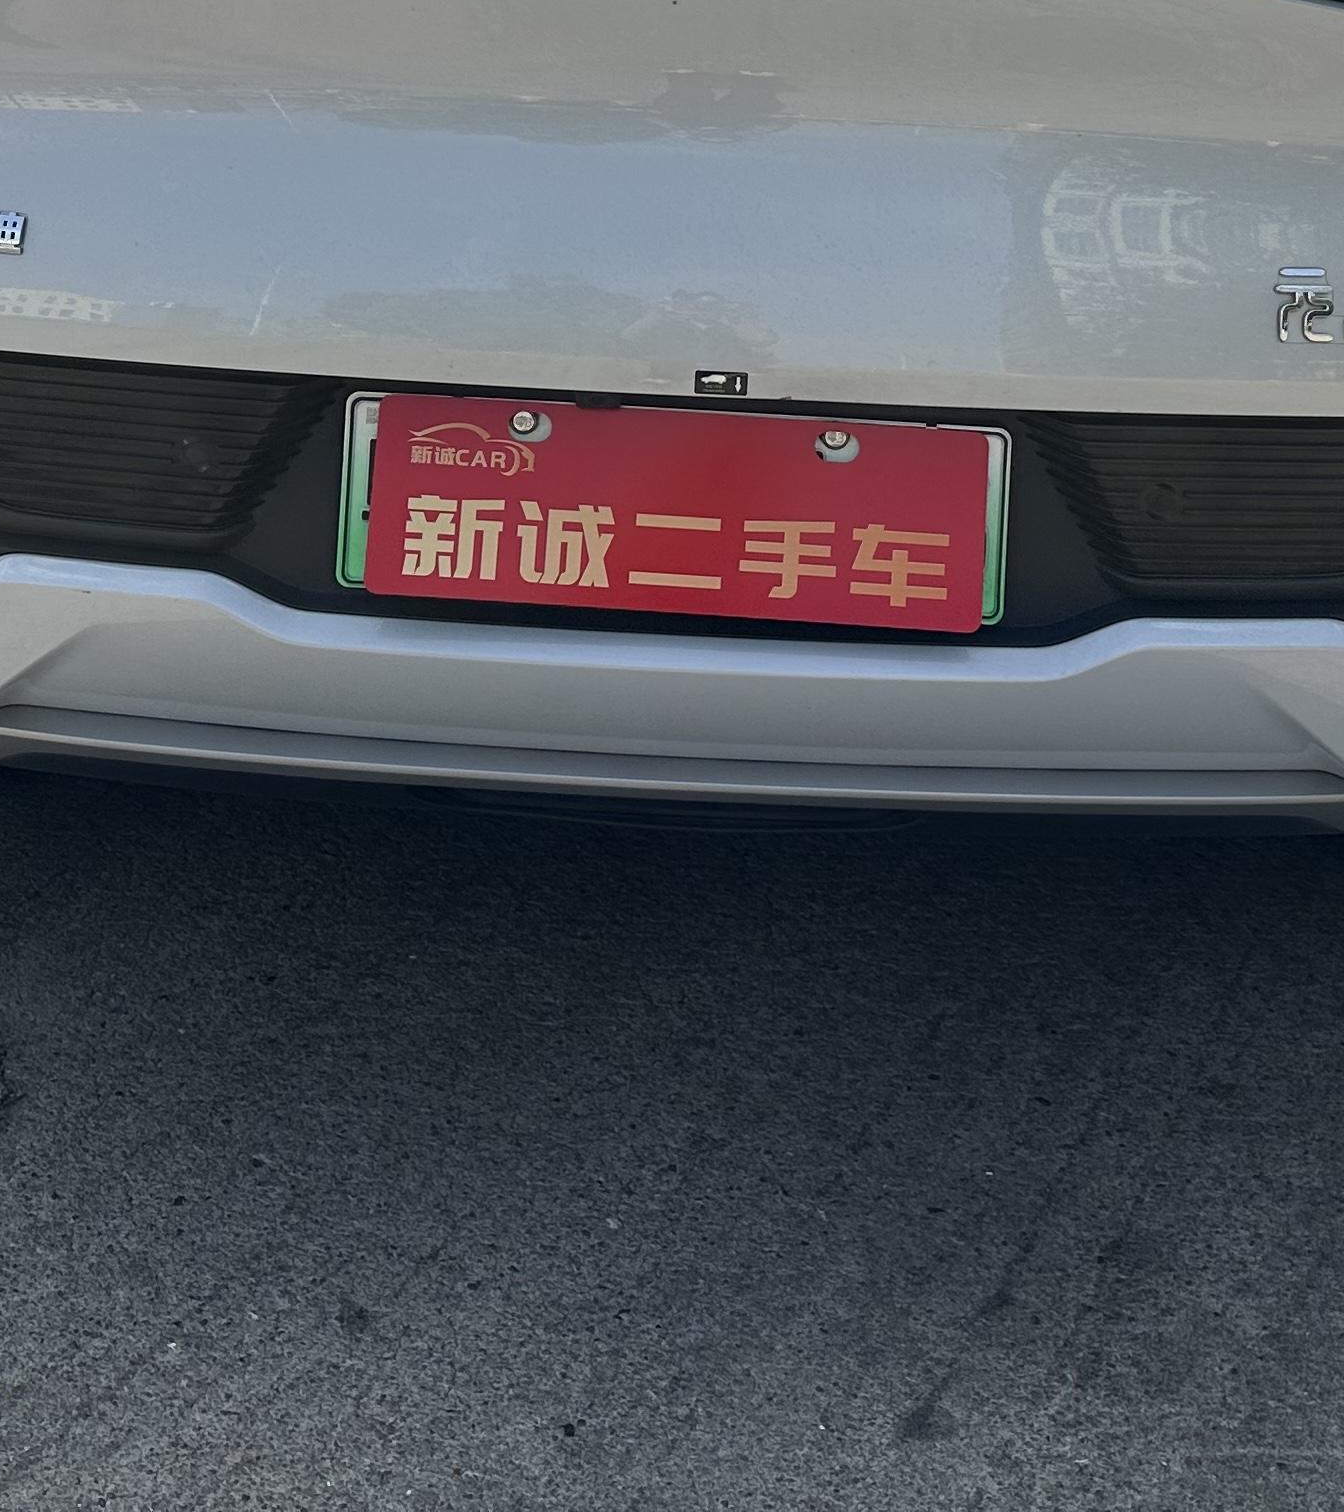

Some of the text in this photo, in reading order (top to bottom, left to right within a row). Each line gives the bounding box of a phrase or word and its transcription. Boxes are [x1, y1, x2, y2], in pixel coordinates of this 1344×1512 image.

[1274, 267, 1334, 342] 元
[410, 445, 507, 469] 新诚CAR
[401, 494, 951, 608] 新诚二手车
